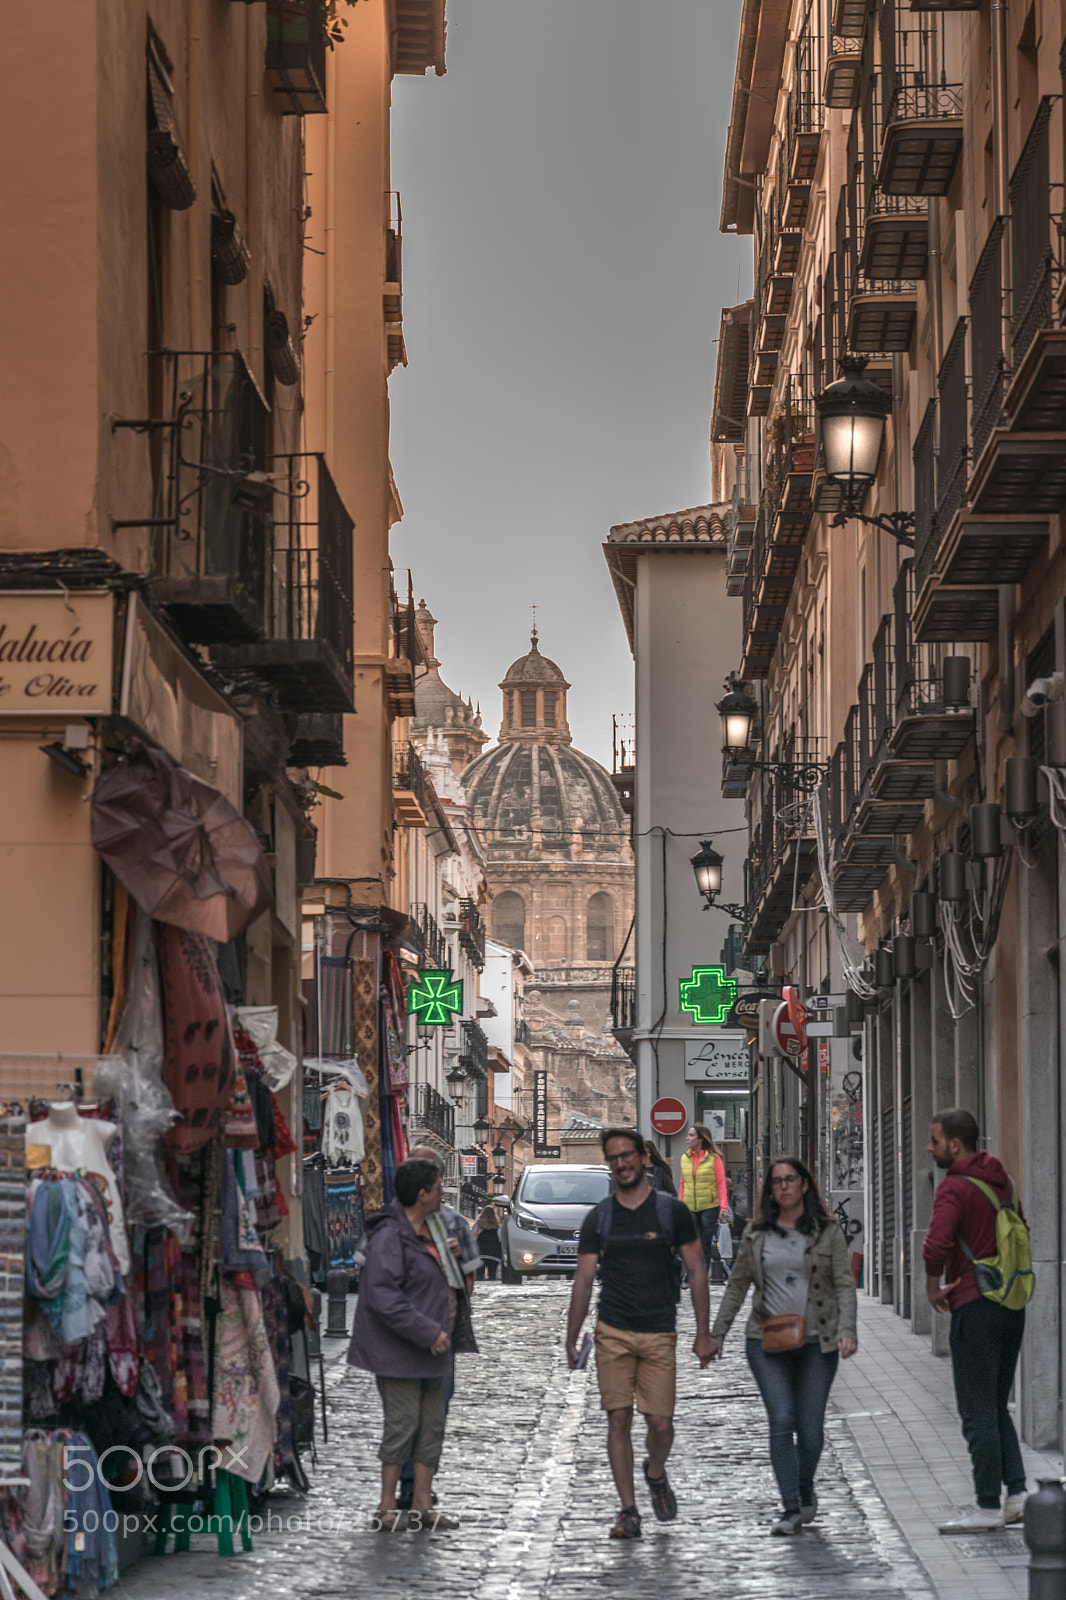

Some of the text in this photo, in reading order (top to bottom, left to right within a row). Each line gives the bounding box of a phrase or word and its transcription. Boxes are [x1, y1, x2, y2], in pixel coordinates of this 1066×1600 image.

[24, 673, 98, 697] Oliva
[537, 1072, 545, 1143] FONDA SANCHEZ
[561, 1246, 578, 1254] 453
